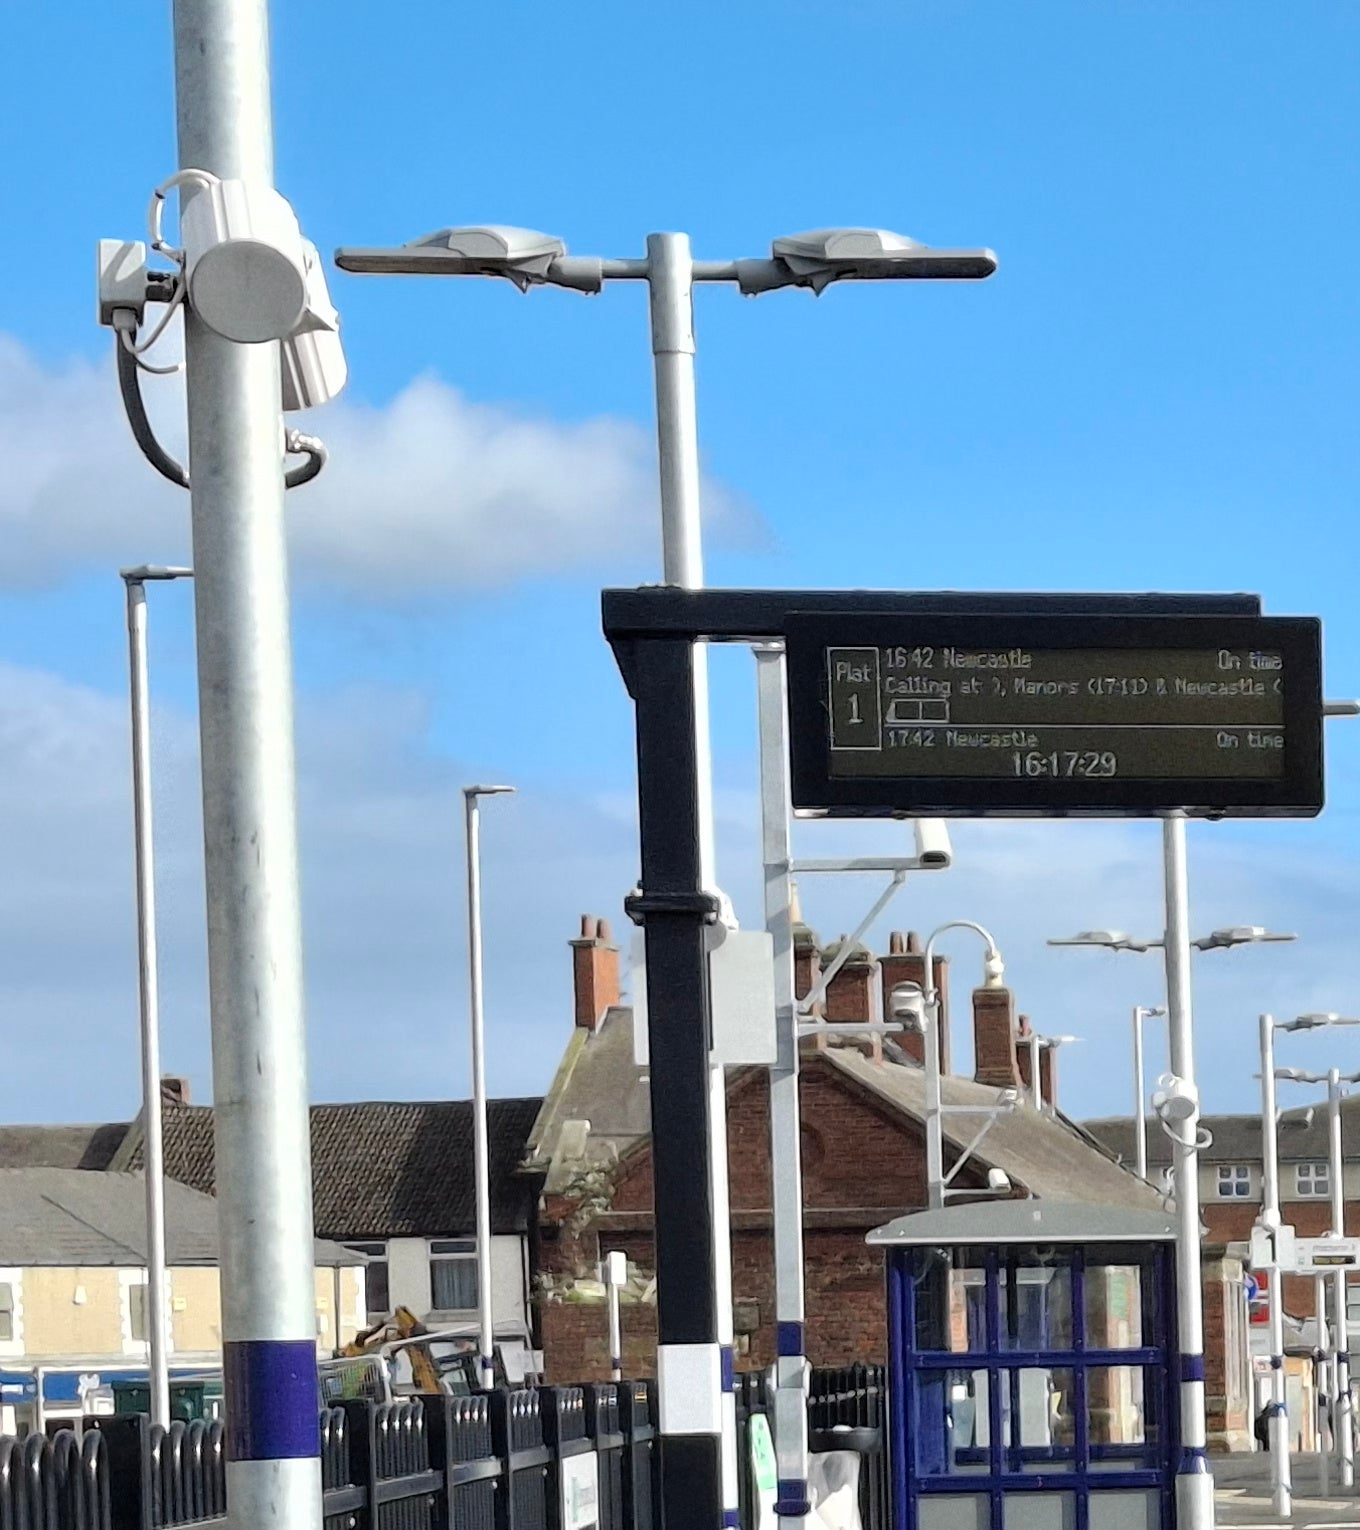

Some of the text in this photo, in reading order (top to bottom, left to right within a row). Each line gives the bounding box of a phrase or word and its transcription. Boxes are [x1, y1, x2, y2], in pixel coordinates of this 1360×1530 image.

[943, 648, 1033, 670] Newcastle
[1218, 649, 1241, 670] On
[1249, 651, 1283, 670] time
[836, 661, 872, 683] Plat
[885, 676, 952, 698] Calling
[960, 676, 984, 695] at
[1014, 677, 1080, 696] Manors
[1175, 677, 1266, 696] Newcastle
[848, 693, 864, 724] 1
[946, 729, 1040, 748] Newcastle
[1217, 731, 1239, 748] On
[1248, 731, 1285, 749] time
[1013, 751, 1117, 778] 16:17:29
